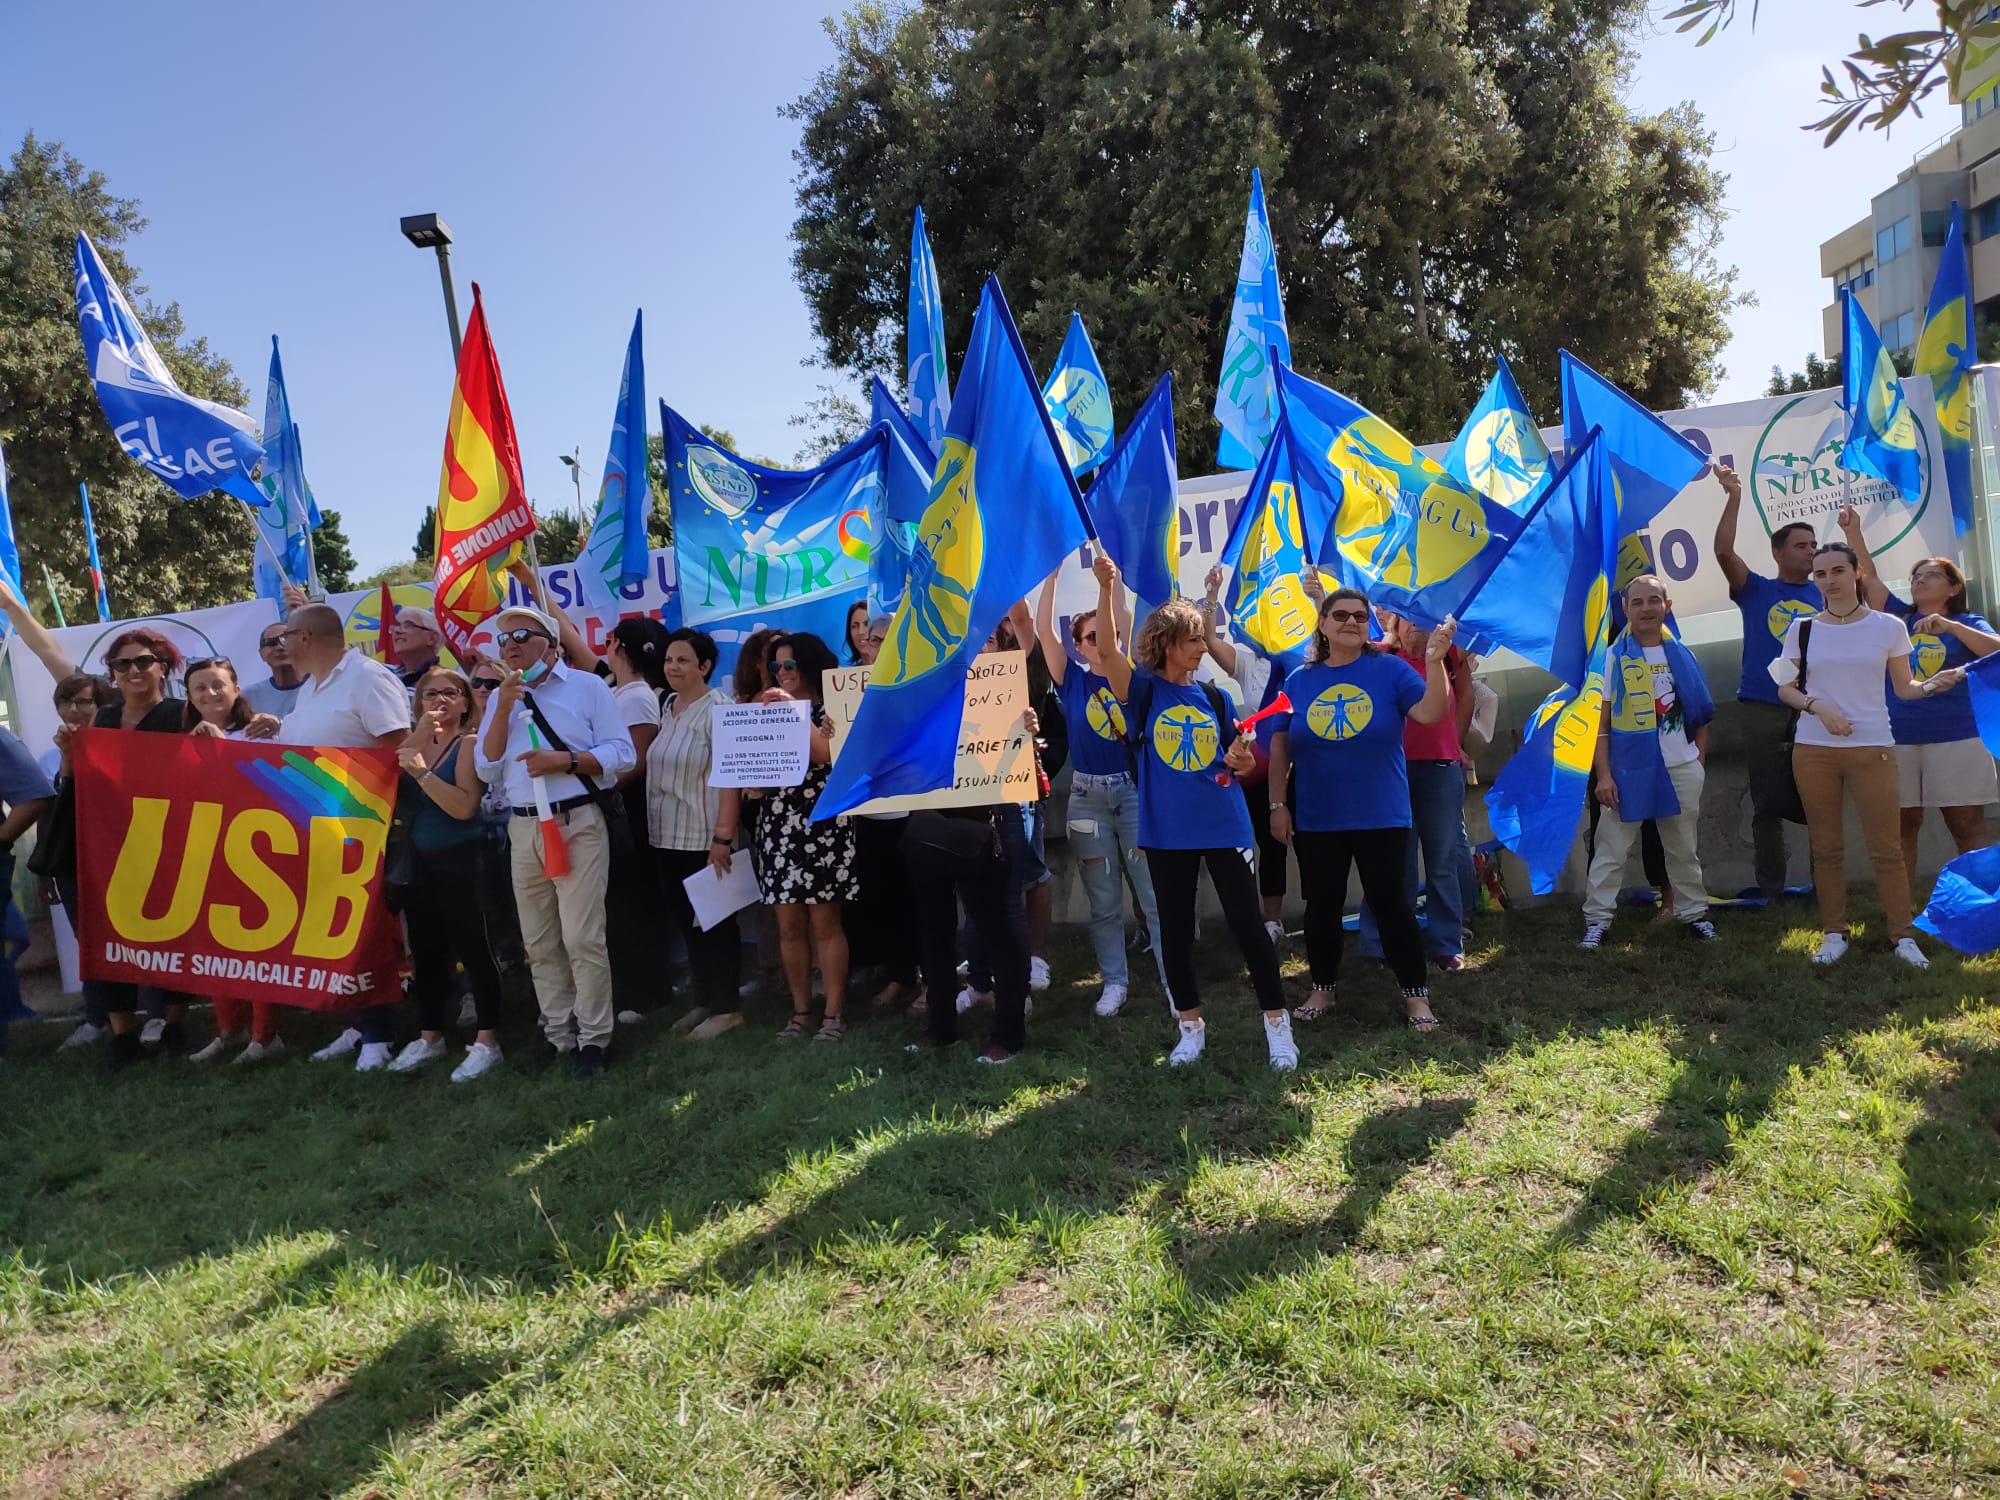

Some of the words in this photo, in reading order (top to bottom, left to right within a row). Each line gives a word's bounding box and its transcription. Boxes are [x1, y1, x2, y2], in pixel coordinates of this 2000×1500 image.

[1777, 493, 1828, 510] SINDACATO
[760, 717, 800, 725] GENERALE
[106, 796, 388, 960] USB
[106, 942, 185, 974] UNIONE
[191, 954, 305, 988] SINDACALE
[308, 968, 326, 991] DI
